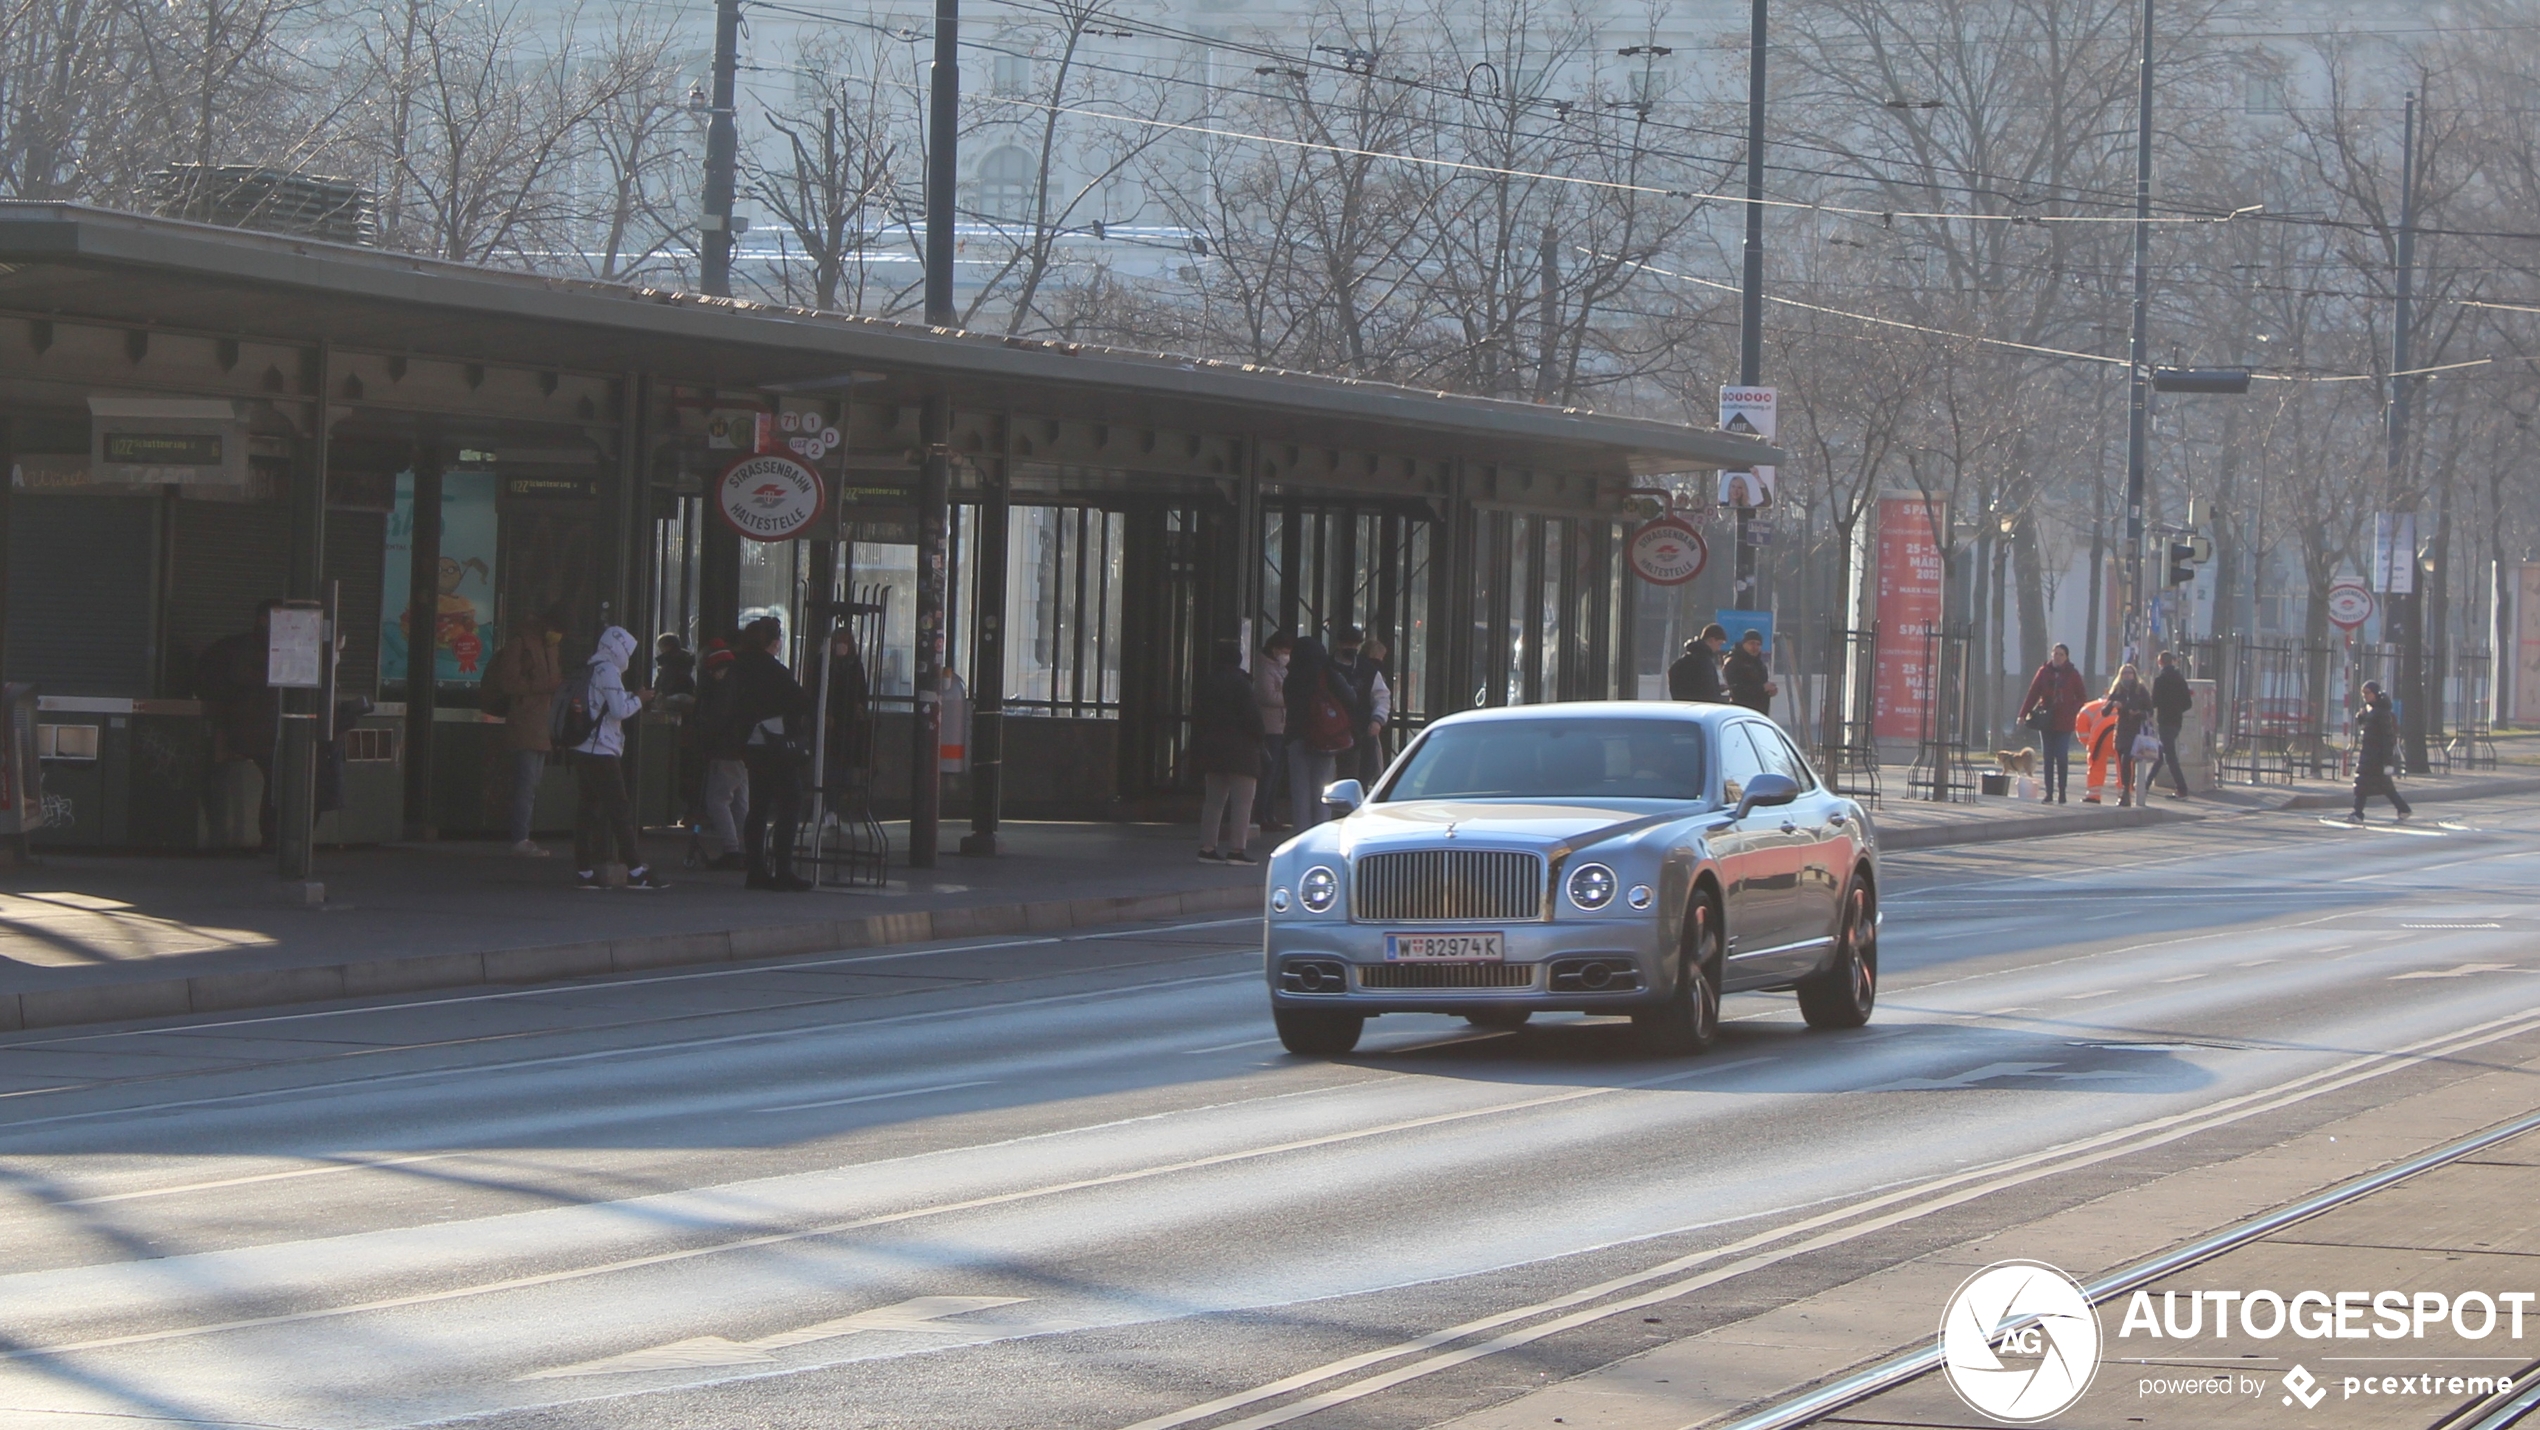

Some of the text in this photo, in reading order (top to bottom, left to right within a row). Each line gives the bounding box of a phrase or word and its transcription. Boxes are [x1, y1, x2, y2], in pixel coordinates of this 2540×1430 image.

[783, 415, 797, 427] 71
[808, 416, 815, 428] 1
[1730, 422, 1748, 432] AUF
[825, 432, 835, 444] D
[811, 443, 820, 455] 2
[728, 460, 812, 495] STRASSENBAHN
[1903, 504, 1941, 516] SPAK
[731, 502, 807, 531] HALTESTELLE
[1638, 529, 1698, 552] STRASSENBAHN
[1906, 543, 1921, 554] 25
[1640, 557, 1695, 577] HALTESTELLE
[1899, 625, 1936, 636] SPAK
[1902, 663, 1917, 675] 25
[1398, 939, 1411, 957] W
